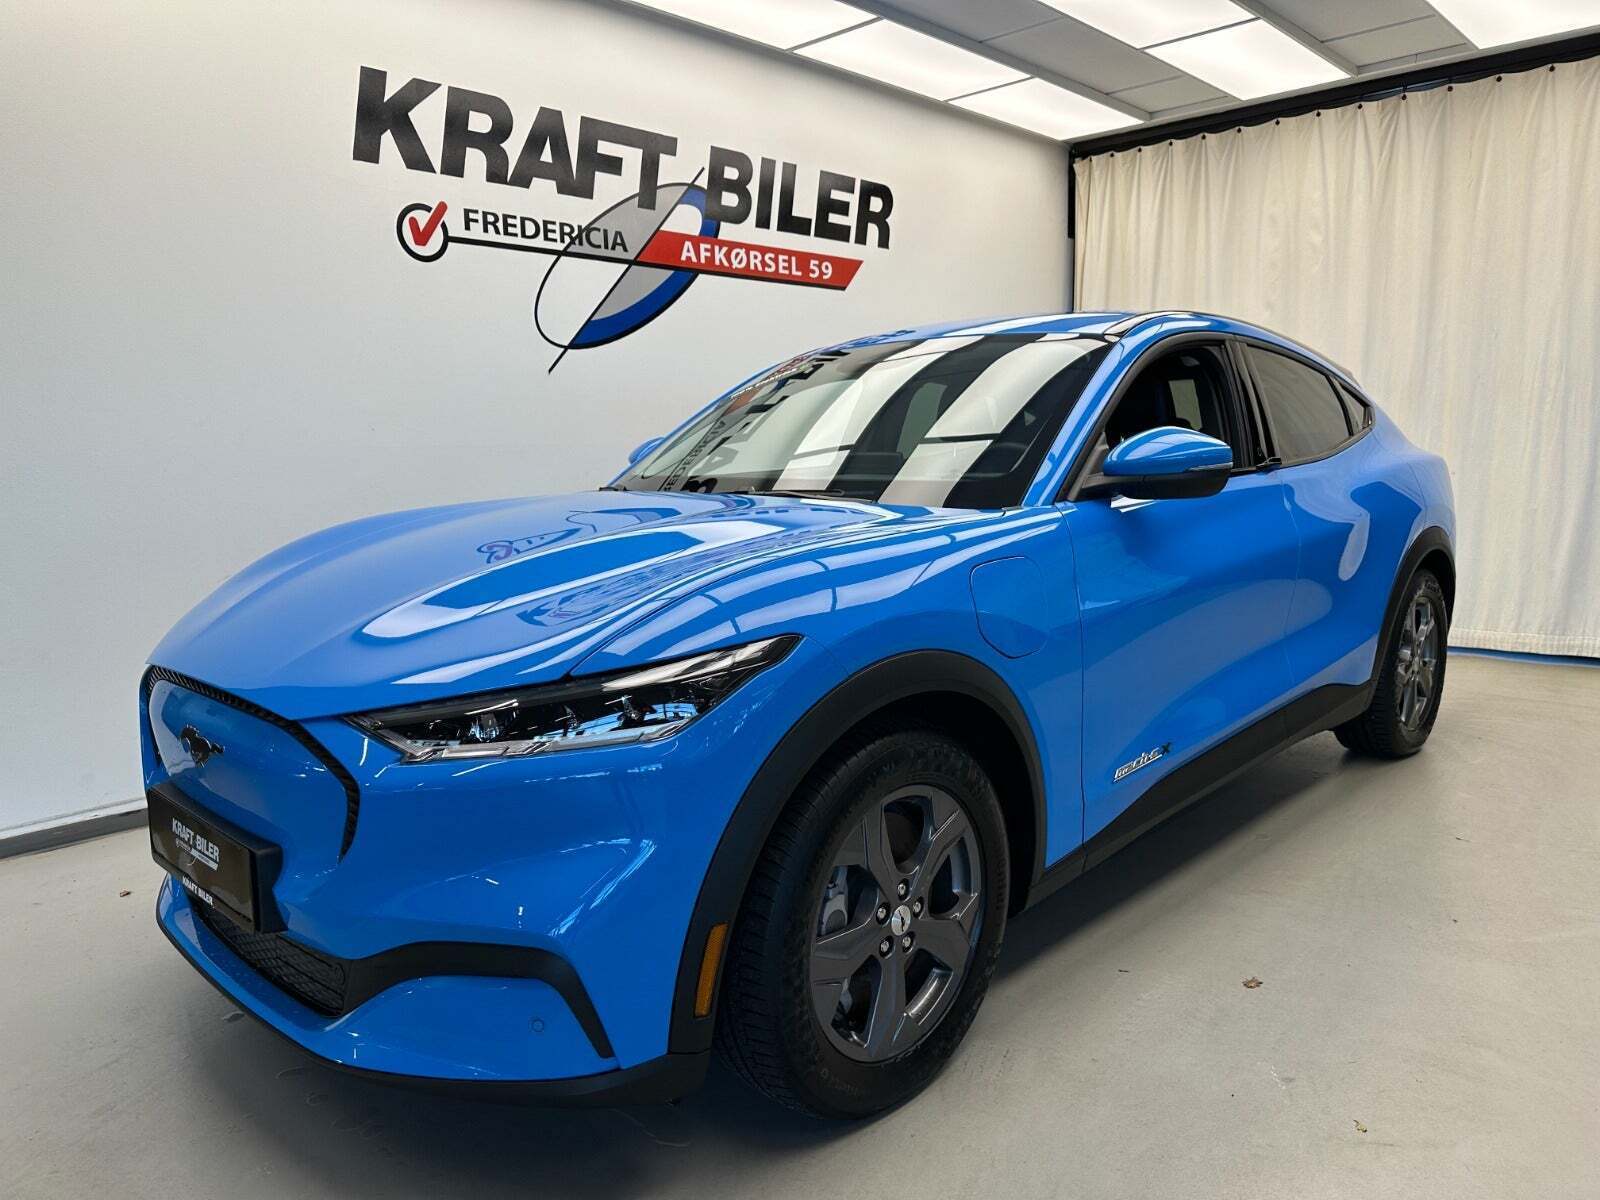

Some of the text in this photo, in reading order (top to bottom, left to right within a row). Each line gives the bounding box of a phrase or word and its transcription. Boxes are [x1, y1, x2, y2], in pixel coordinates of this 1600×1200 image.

[353, 65, 894, 249] KRAFT BILER
[463, 208, 833, 280] FREDERICIA AFKØRSEL 59
[172, 817, 194, 845] KRAFT
[196, 834, 219, 862] BILER
[182, 875, 213, 905] KRAFT BILER
